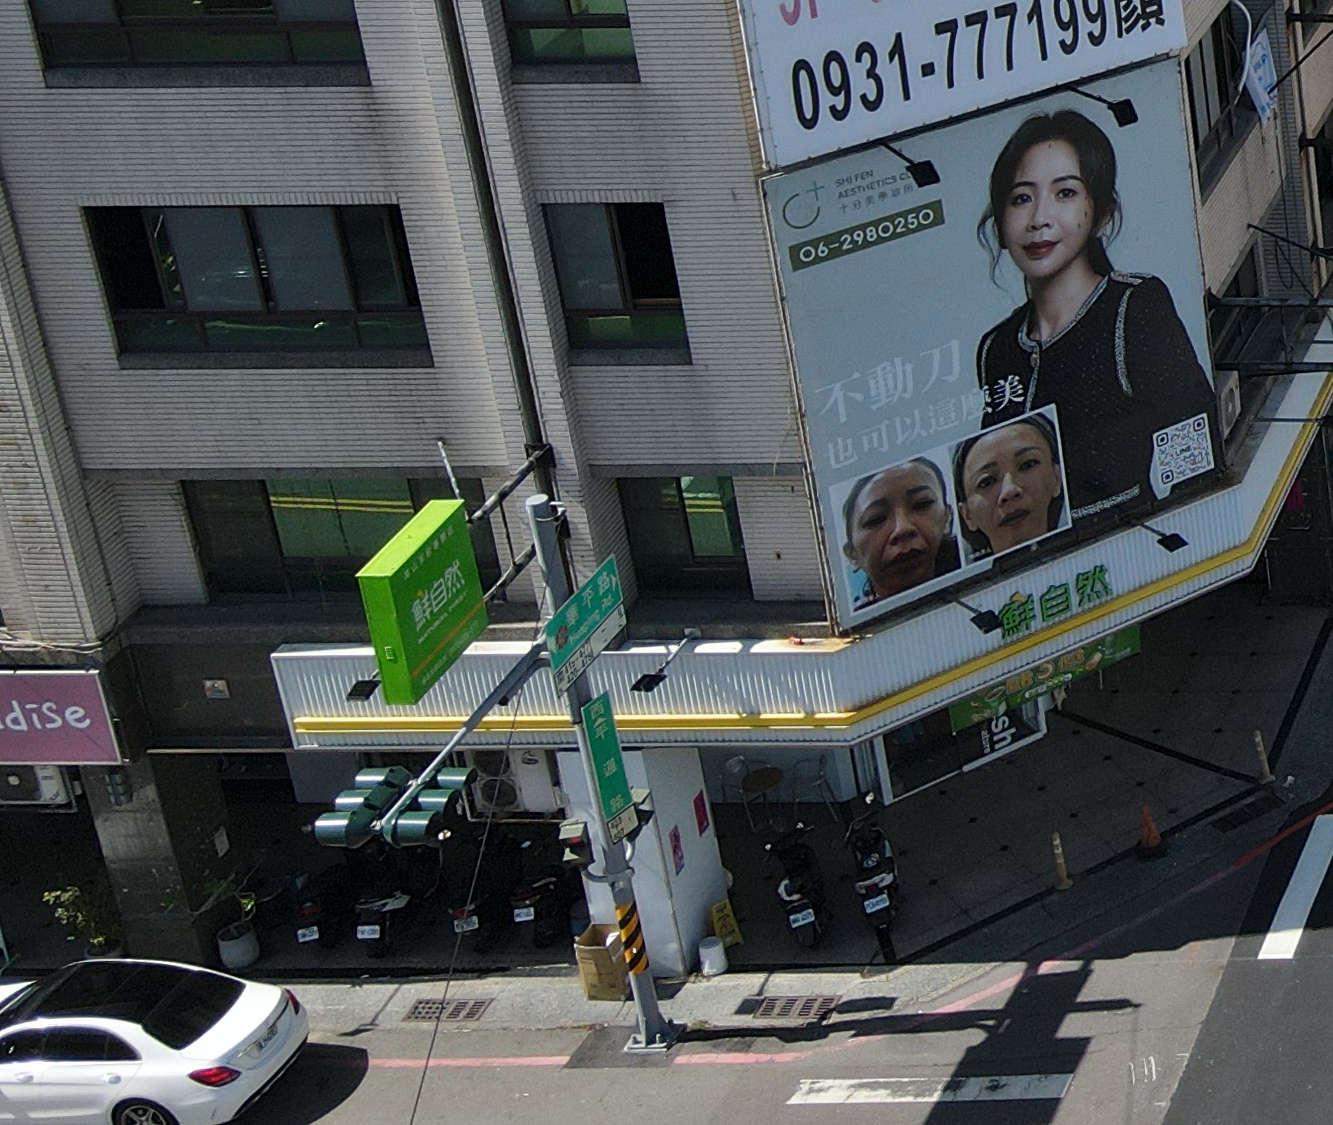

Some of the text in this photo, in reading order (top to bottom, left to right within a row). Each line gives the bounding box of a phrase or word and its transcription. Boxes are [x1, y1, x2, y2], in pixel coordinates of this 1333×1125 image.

[838, 176, 897, 200] AESTHETICS
[799, 208, 934, 263] 06-2980250
[814, 339, 961, 424] 不動刀
[823, 374, 1026, 470] 也可以這麼美
[411, 559, 466, 632] 鮮自然
[998, 563, 1115, 640] 鮮自然
[0, 699, 92, 732] dise
